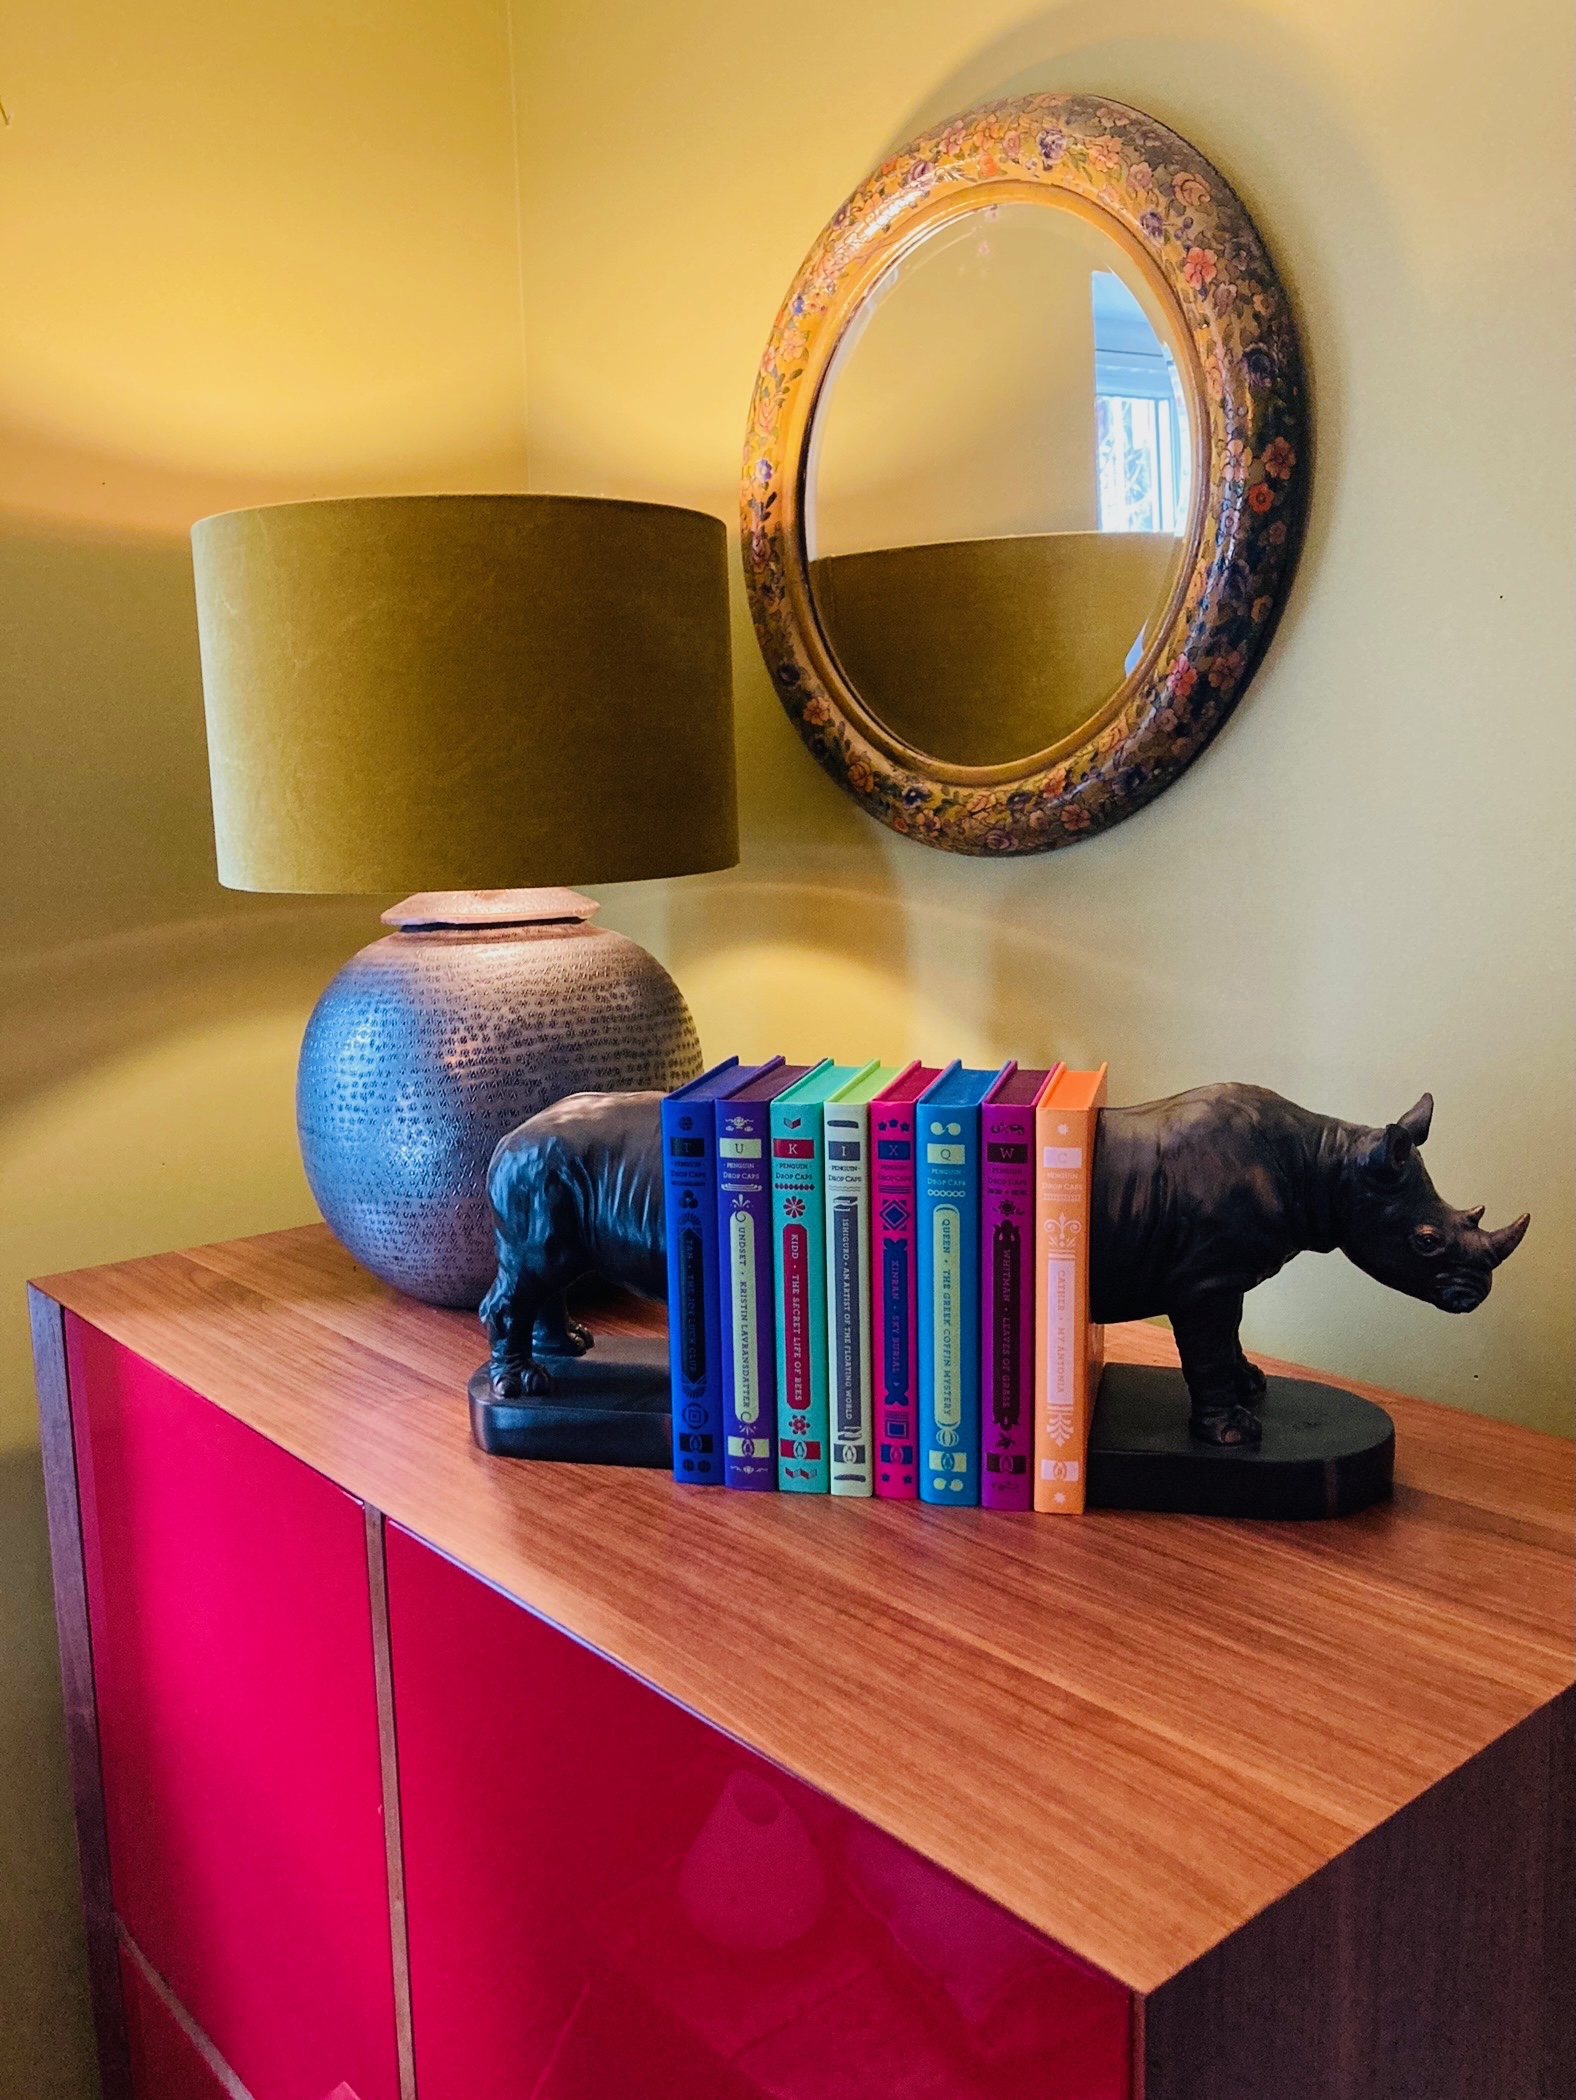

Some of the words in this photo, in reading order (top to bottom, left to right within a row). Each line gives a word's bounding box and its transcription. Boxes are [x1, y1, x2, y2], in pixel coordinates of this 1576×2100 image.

[734, 1143, 745, 1154] U
[788, 1143, 798, 1154] K
[841, 1145, 847, 1157] I
[889, 1144, 898, 1156] X
[940, 1148, 951, 1161] Q
[1000, 1147, 1014, 1159] W
[1057, 1152, 1067, 1164] C
[738, 1227, 747, 1266] UNDSET
[791, 1234, 799, 1260] KIDD
[941, 1218, 951, 1254] QUEEN
[792, 1274, 800, 1294] THE
[843, 1268, 850, 1280] AN
[891, 1260, 900, 1300] XINRAN
[943, 1269, 951, 1290] THE
[1002, 1249, 1011, 1302] WHITMAN
[740, 1281, 748, 1321] KRISTIN
[1057, 1270, 1066, 1311] CATHER
[793, 1297, 801, 1334] SECRET
[844, 1313, 851, 1324] OF
[943, 1292, 951, 1326] GREEK
[892, 1315, 900, 1334] SKY
[1002, 1317, 1011, 1355] LEAVES
[1057, 1327, 1065, 1343] MY
[793, 1337, 801, 1358] LIFE
[892, 1337, 900, 1373] BURIAL
[943, 1328, 951, 1367] COFFIN
[741, 1324, 751, 1408] LAVRANSDATTER
[794, 1361, 802, 1374] OF
[1002, 1357, 1010, 1371] OF
[794, 1377, 803, 1401] BEES
[943, 1369, 952, 1416] MYSTERY
[1002, 1374, 1011, 1408] GRASS
[845, 1388, 853, 1420] WORLD
